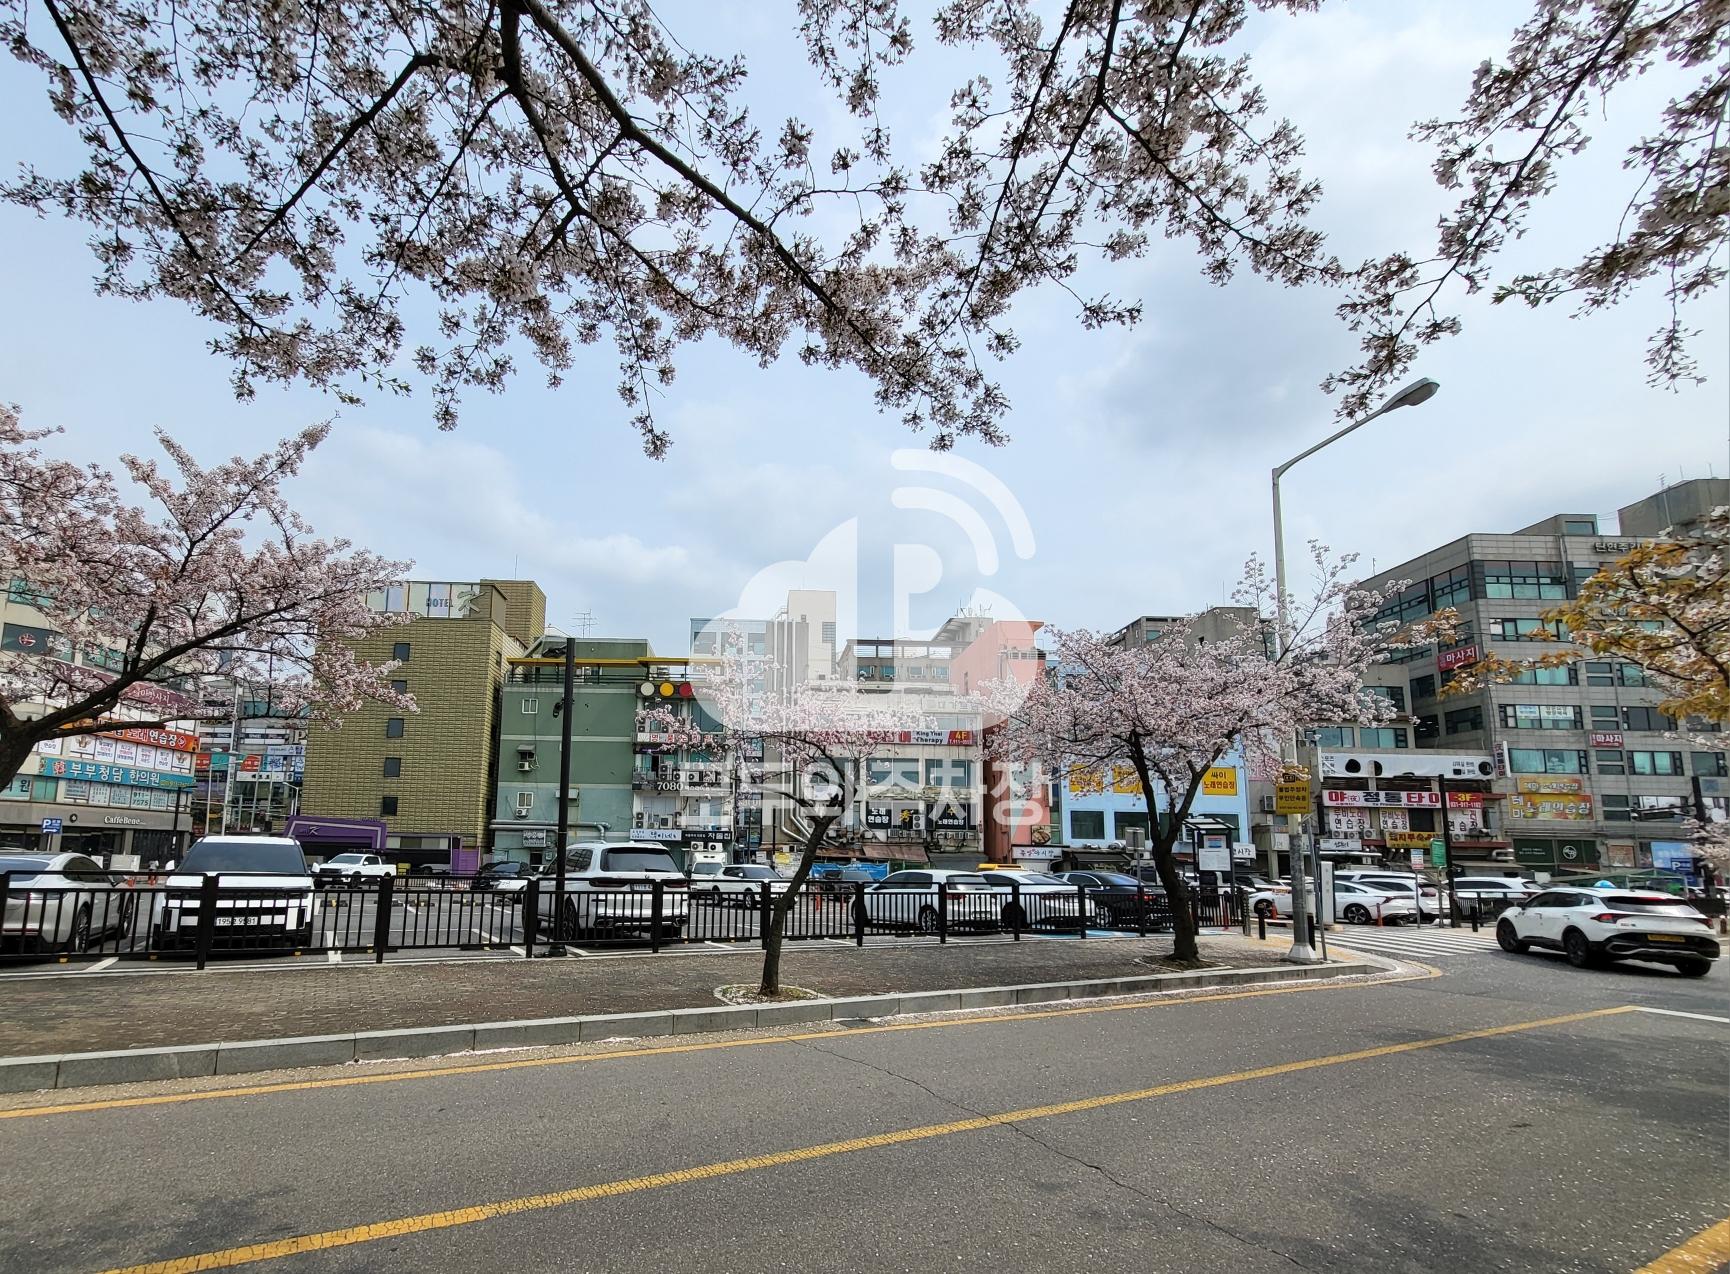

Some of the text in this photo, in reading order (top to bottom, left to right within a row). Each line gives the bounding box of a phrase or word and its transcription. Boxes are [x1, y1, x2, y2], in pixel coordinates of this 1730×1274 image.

[426, 598, 454, 608] HOTEL
[1446, 647, 1475, 663] 마사지
[955, 731, 968, 739] 4F
[1596, 734, 1623, 744] 마사지
[69, 761, 124, 783] 부부청담
[129, 769, 160, 787] 한의원
[656, 782, 684, 791] 7080
[1203, 780, 1235, 790] 노래연습장
[871, 807, 886, 815] 노래
[867, 815, 889, 823] 연습장
[1334, 818, 1365, 830] 연습장
[1382, 819, 1408, 830] 연습장
